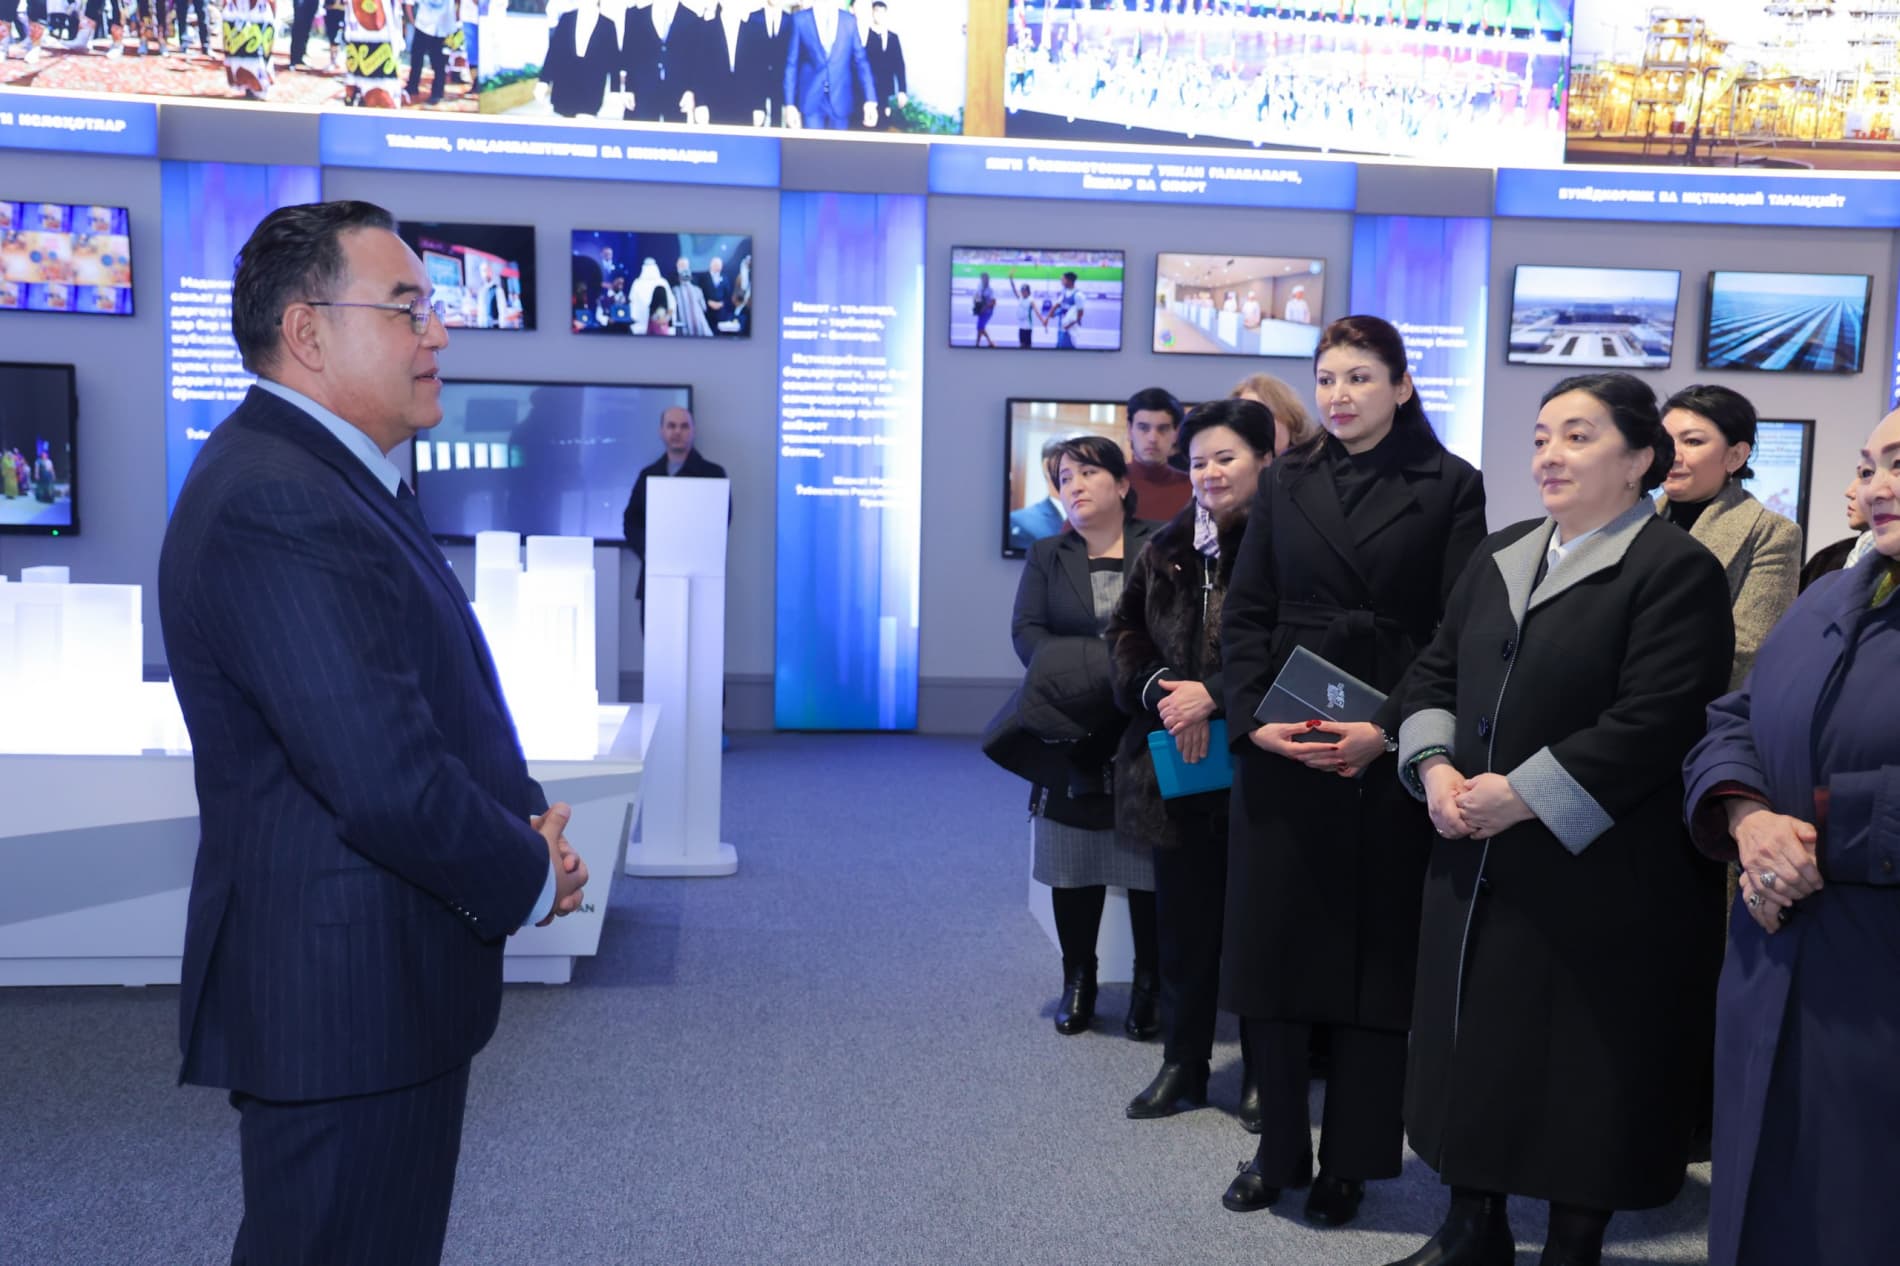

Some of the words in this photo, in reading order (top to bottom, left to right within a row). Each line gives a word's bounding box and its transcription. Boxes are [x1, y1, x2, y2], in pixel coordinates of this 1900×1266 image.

[601, 145, 623, 159] ВА
[1136, 178, 1157, 191] ВА
[1659, 190, 1678, 203] ВА
